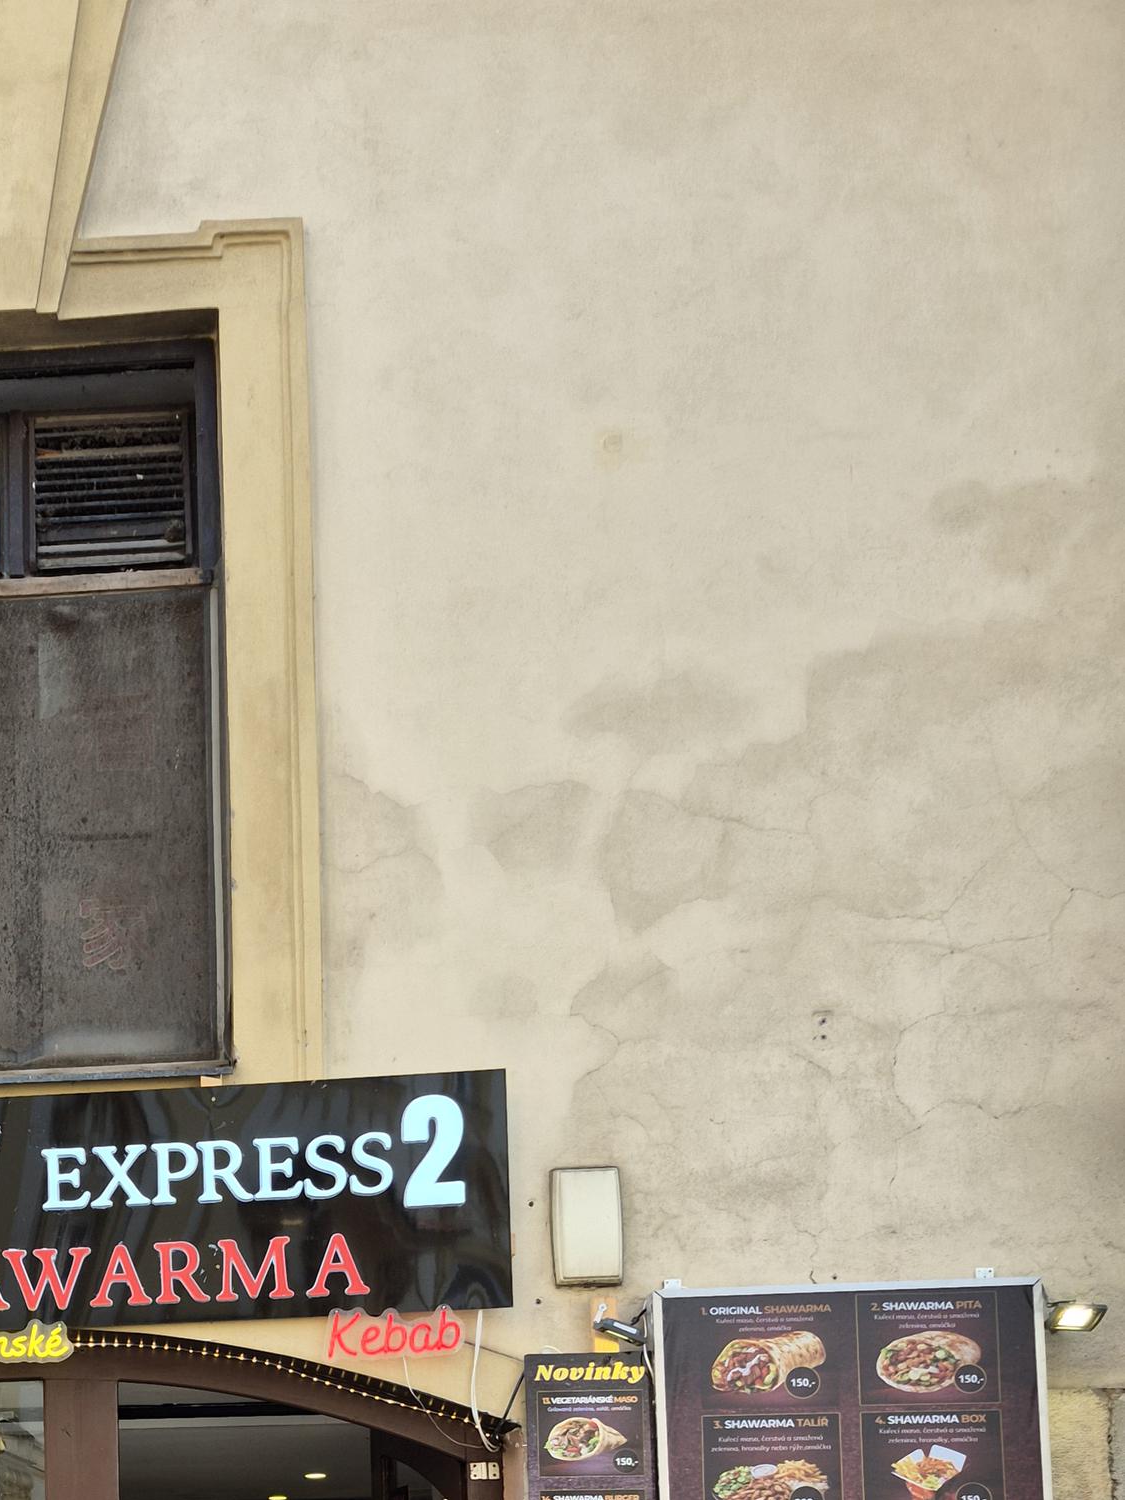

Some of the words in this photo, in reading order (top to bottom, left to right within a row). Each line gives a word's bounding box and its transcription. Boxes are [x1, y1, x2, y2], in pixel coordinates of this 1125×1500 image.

[41, 1131, 393, 1212] EXPRESS
[401, 1094, 466, 1209] 2
[709, 1306, 763, 1315] ORIGINAL
[764, 1304, 832, 1314] SHAWARMA
[882, 1301, 954, 1311] SHAWARMA
[956, 1300, 982, 1309] PITA
[328, 1307, 461, 1359] Kebab
[535, 1362, 645, 1384] Novinky
[790, 1378, 816, 1388] 150,-
[957, 1374, 984, 1385] 150,-
[724, 1419, 795, 1429] SHAWARMA
[887, 1414, 959, 1424] SHAWARMA
[961, 1414, 986, 1423] BOX
[615, 1457, 638, 1467] 150,-
